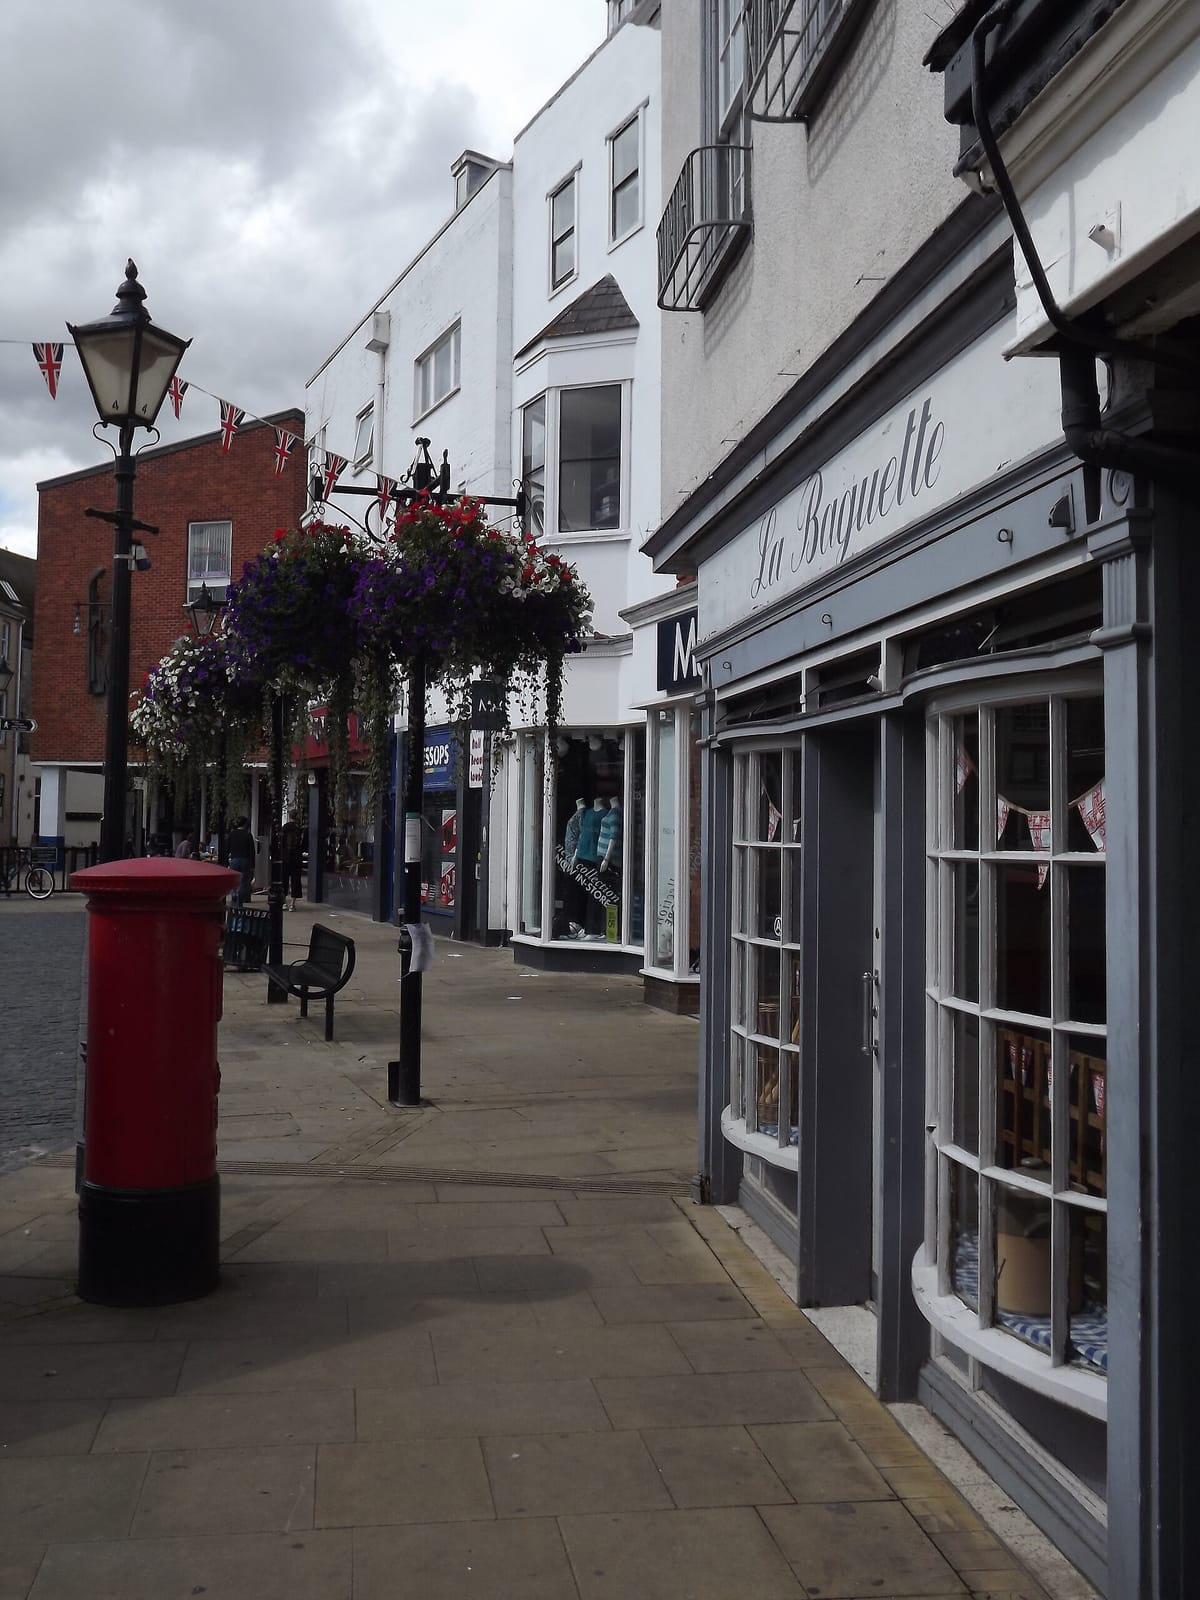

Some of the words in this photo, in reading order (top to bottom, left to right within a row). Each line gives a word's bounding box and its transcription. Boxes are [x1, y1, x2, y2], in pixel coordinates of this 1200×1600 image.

[112, 400, 119, 411] 4
[142, 403, 148, 414] 4
[751, 508, 784, 599] La
[791, 398, 945, 573] Baguette
[424, 744, 449, 766] SSOPS
[575, 873, 612, 908] IN-STORE
[576, 863, 620, 902] collection
